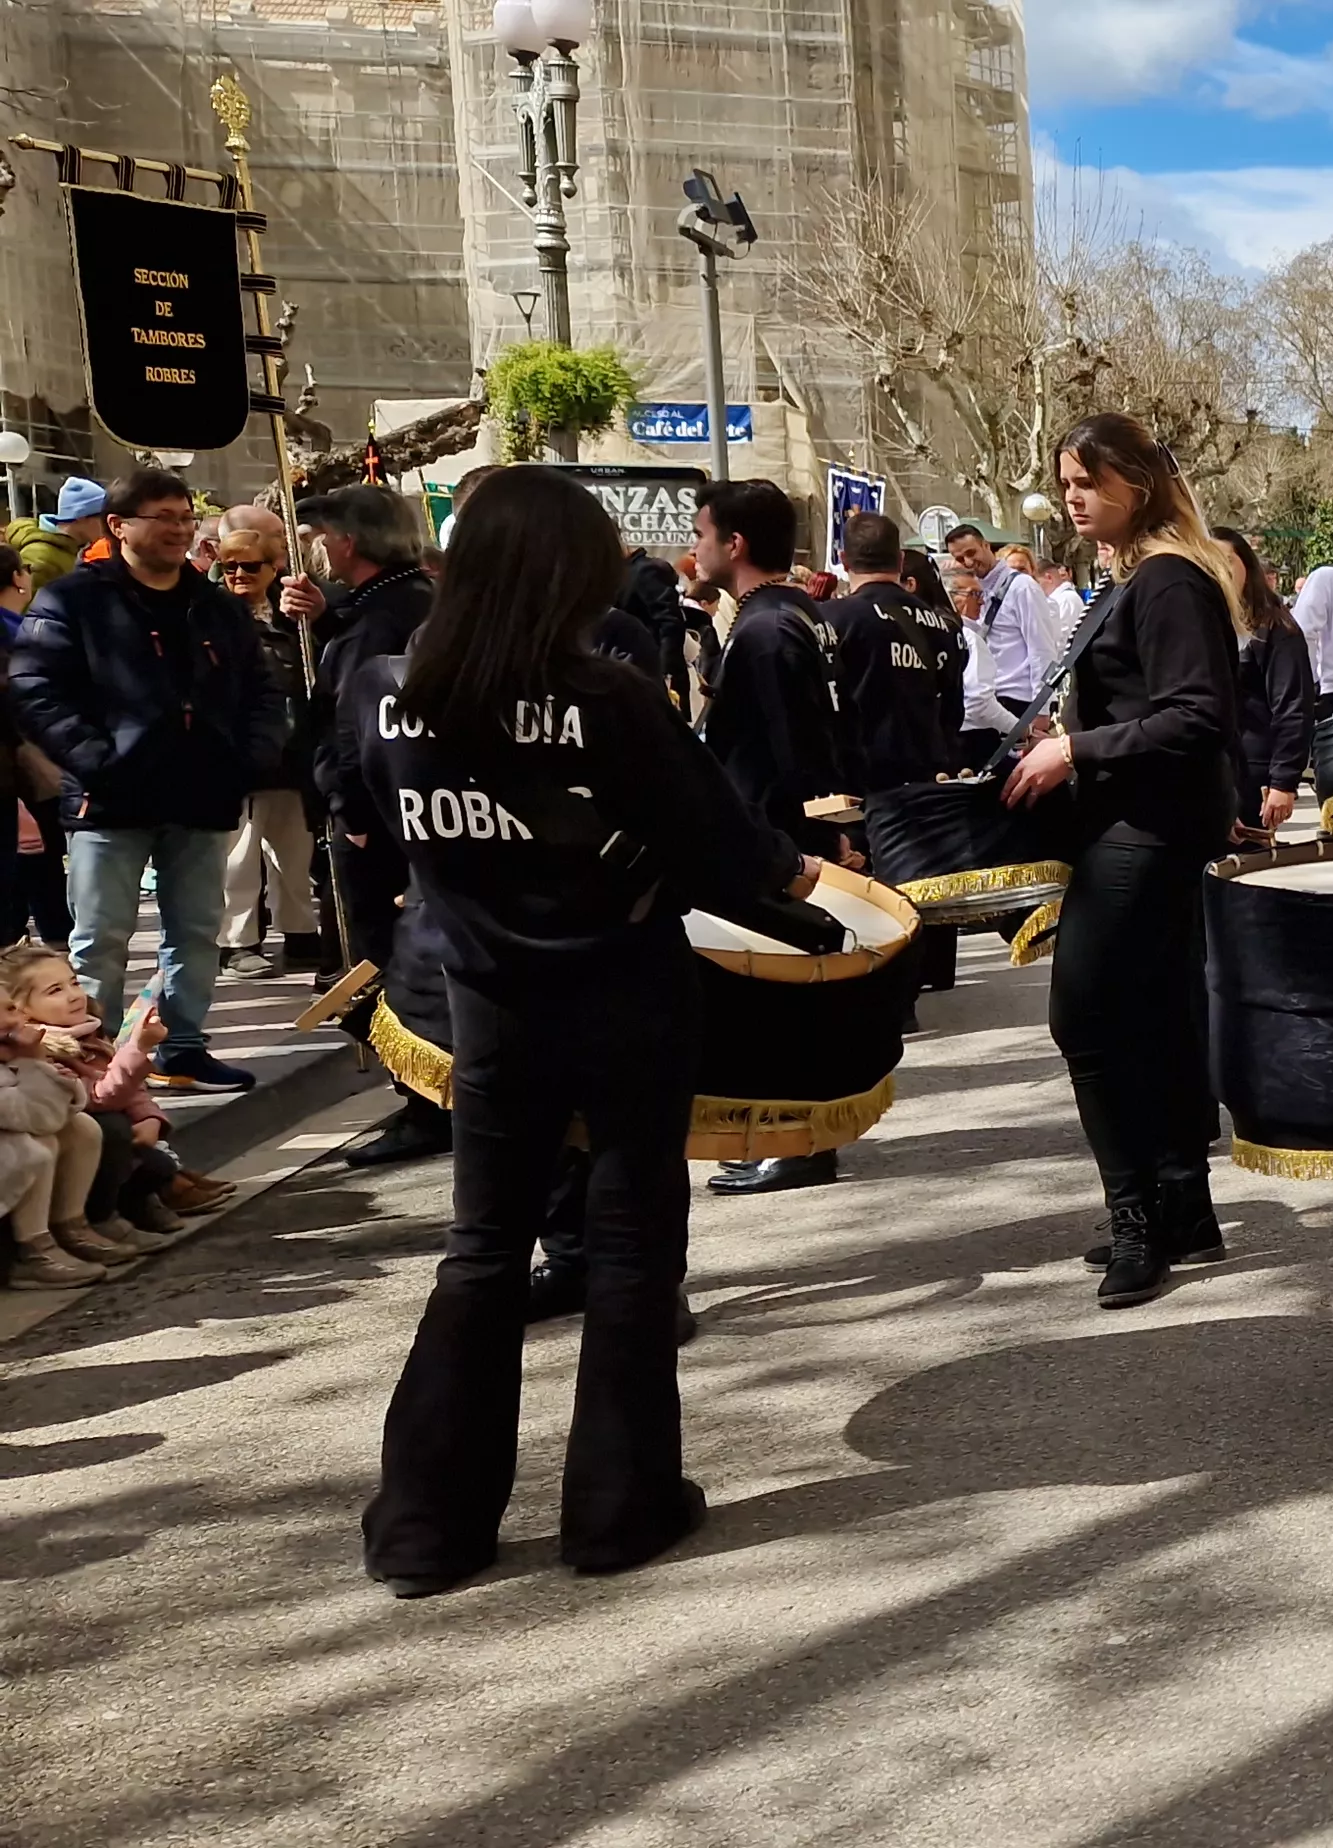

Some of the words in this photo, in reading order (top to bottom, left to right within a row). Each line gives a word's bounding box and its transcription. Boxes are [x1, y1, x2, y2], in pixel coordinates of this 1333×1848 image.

[134, 268, 189, 289] SECCIÓN
[155, 300, 174, 317] DE
[131, 327, 206, 348] TAMBORES
[145, 366, 196, 384] ROBRES
[632, 421, 674, 437] Café
[675, 421, 705, 437] del
[584, 486, 699, 514] NZAS
